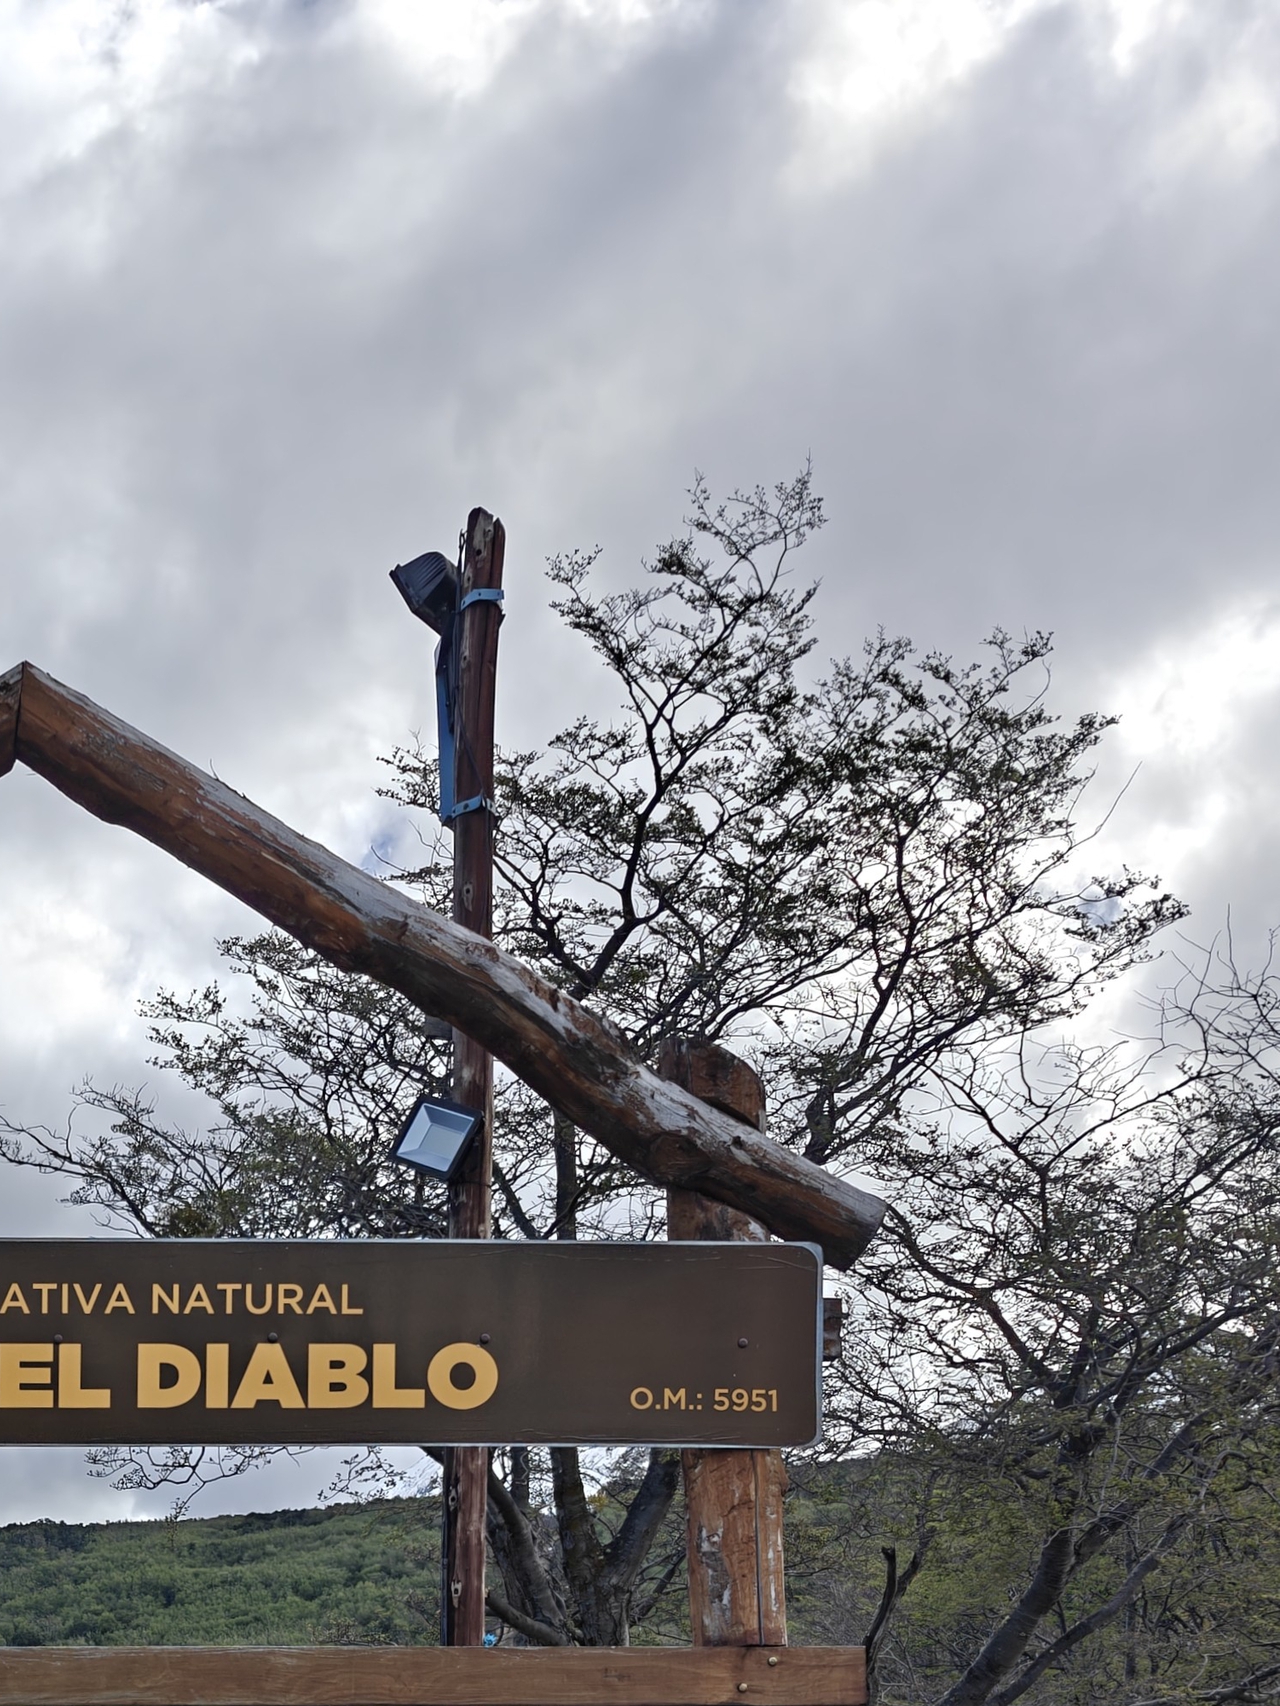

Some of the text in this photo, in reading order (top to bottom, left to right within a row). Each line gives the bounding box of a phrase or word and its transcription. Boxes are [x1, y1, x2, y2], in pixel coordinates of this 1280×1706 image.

[152, 1283, 363, 1315] NATURAL
[137, 1342, 499, 1410] DIABLO
[630, 1387, 778, 1412] O.M.: 5951
